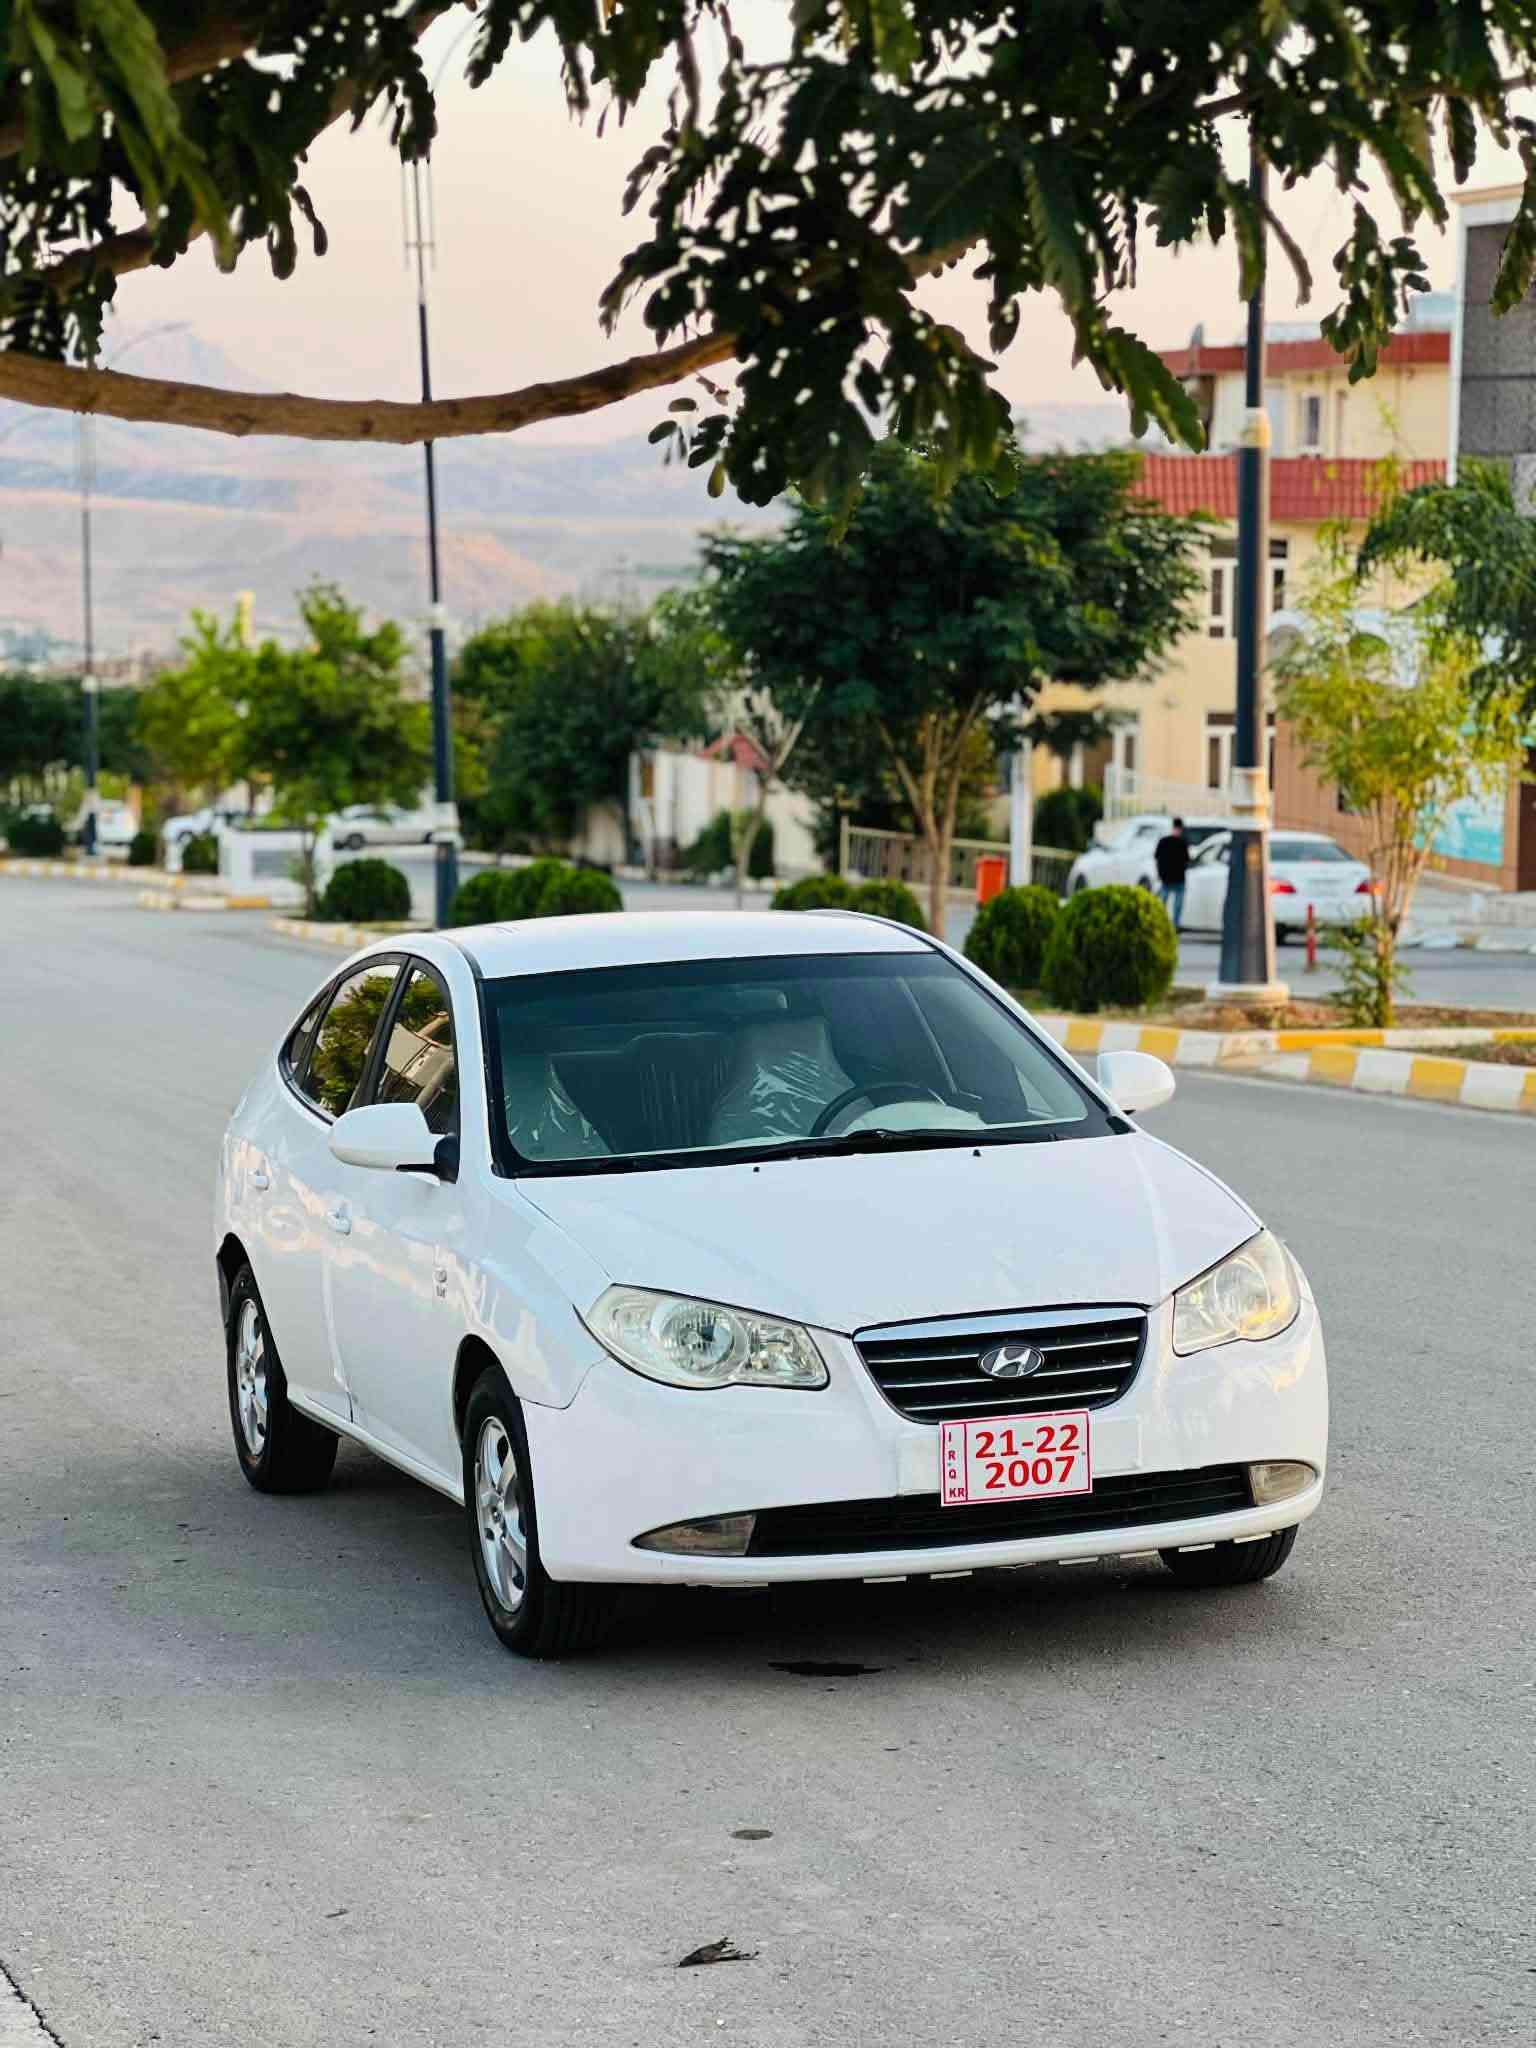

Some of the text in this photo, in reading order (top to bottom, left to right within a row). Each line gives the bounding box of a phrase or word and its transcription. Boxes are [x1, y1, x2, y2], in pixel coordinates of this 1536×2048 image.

[975, 1424, 1080, 1459] 21-22
[985, 1455, 1075, 1489] 2007
[949, 1487, 965, 1498] KR
